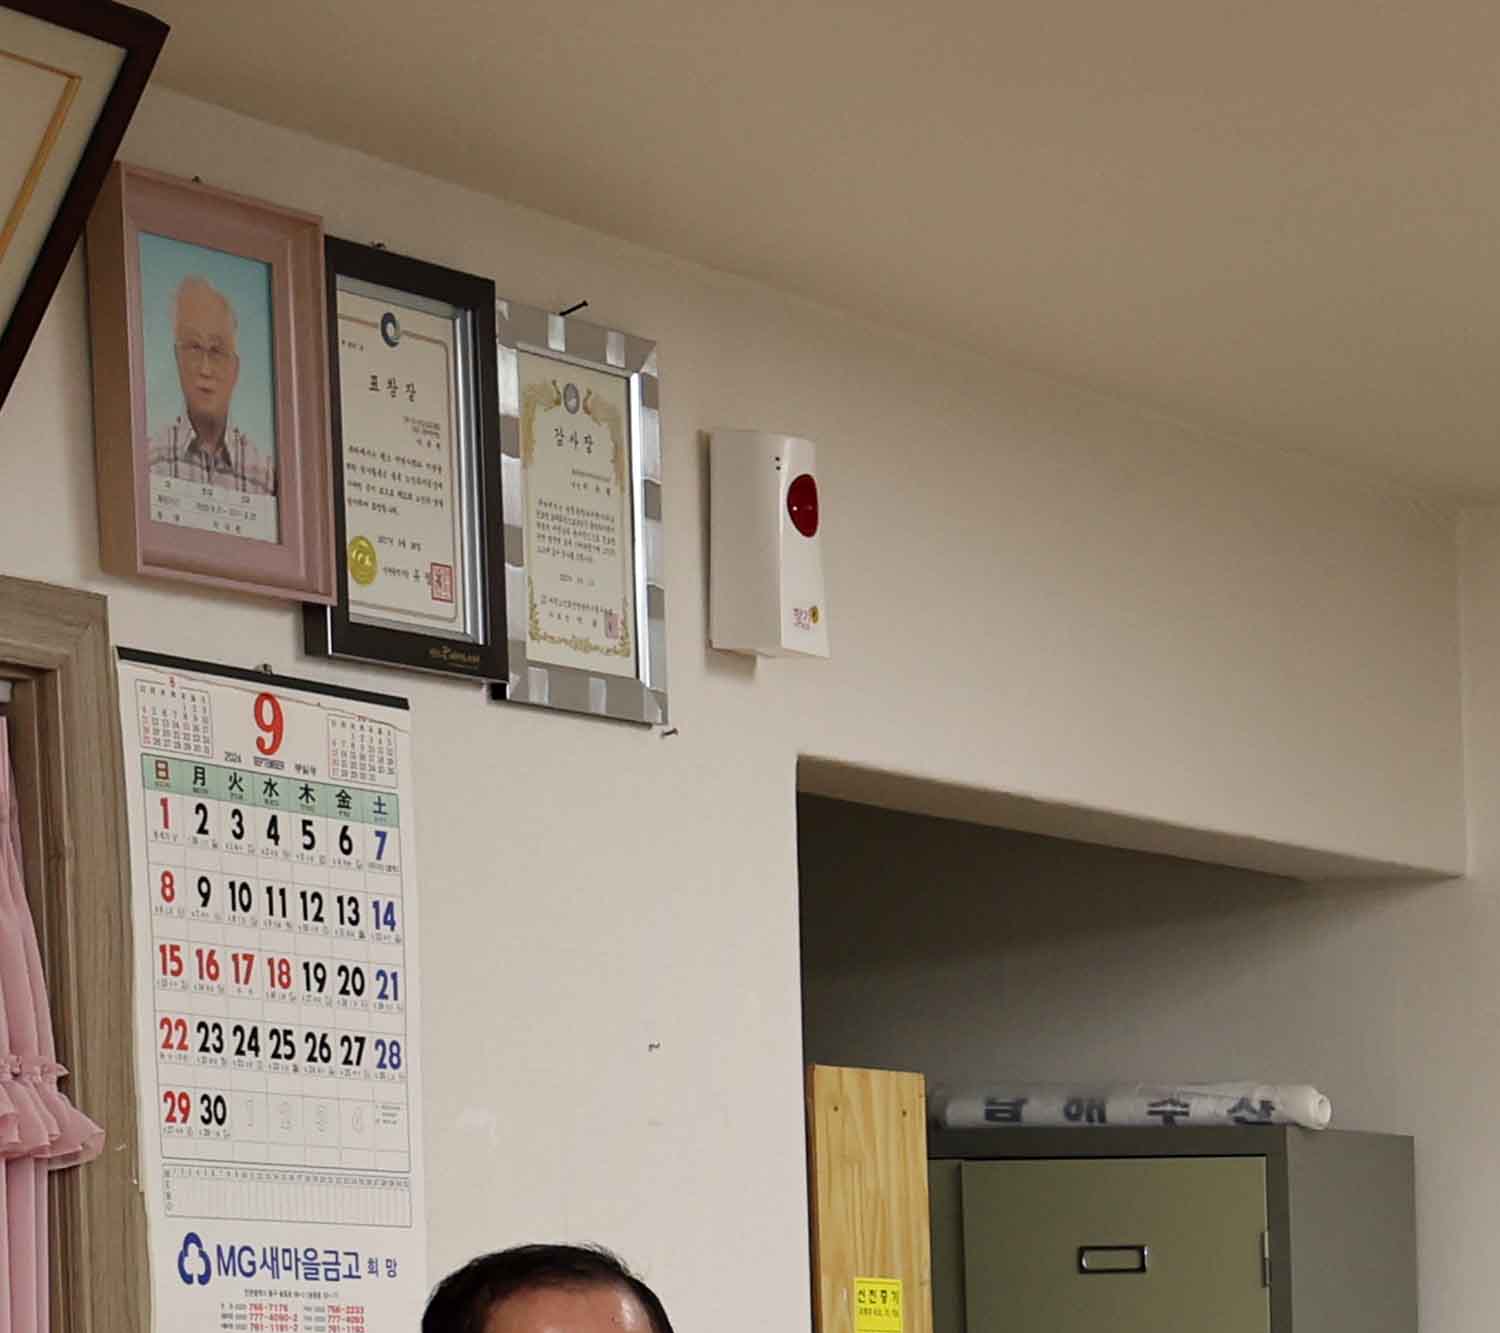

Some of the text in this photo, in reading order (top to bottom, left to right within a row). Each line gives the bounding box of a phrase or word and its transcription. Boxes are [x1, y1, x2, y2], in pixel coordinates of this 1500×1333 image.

[254, 692, 283, 755] 9
[155, 760, 388, 815] 日 月 火 水 木 金 土
[160, 798, 386, 860] 1 2 3 4 5 6 7
[161, 870, 396, 931] 8 9 10 11 12 13 14
[160, 944, 398, 1001] 15 16 17 18 19 20 21
[160, 1017, 400, 1070] 22 23 24 25 26 27 28
[163, 1091, 226, 1126] 29 30
